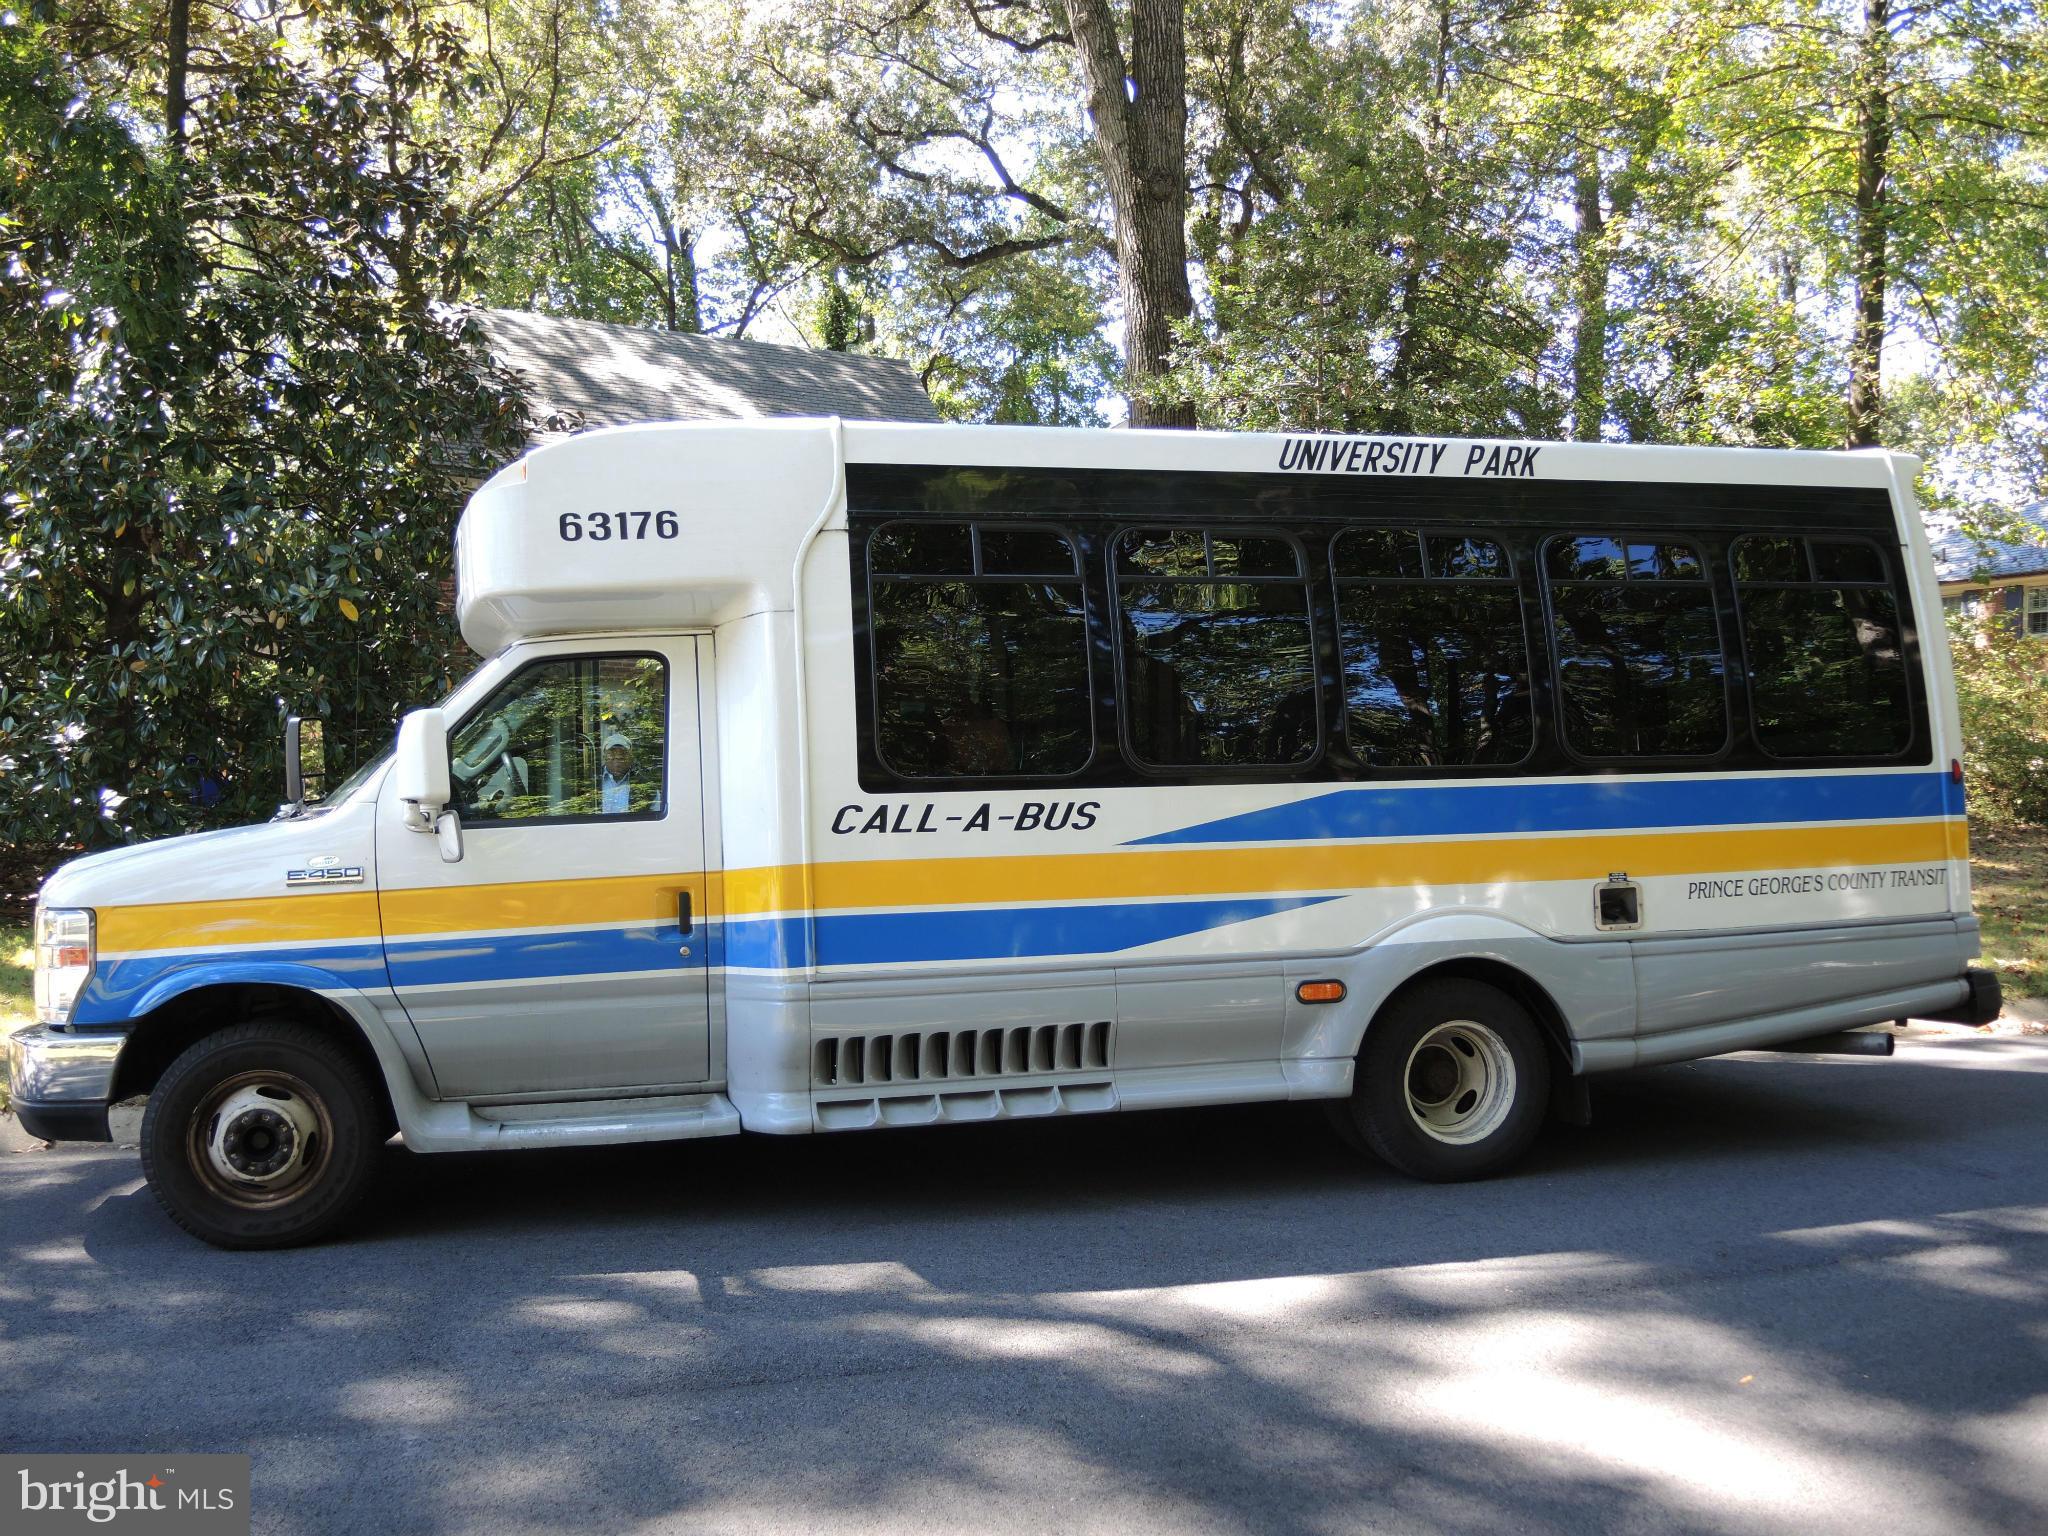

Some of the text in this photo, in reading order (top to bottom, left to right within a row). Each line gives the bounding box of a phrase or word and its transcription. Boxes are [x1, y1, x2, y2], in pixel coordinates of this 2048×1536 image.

[1278, 438, 1542, 477] UNIVERSITY PARK
[559, 510, 679, 542] 63176
[831, 801, 1101, 835] CALL-A-BUS
[1688, 879, 1744, 900] PRINCE
[1828, 871, 1887, 891] COUNTY
[1890, 868, 1948, 888] TRANSIT
